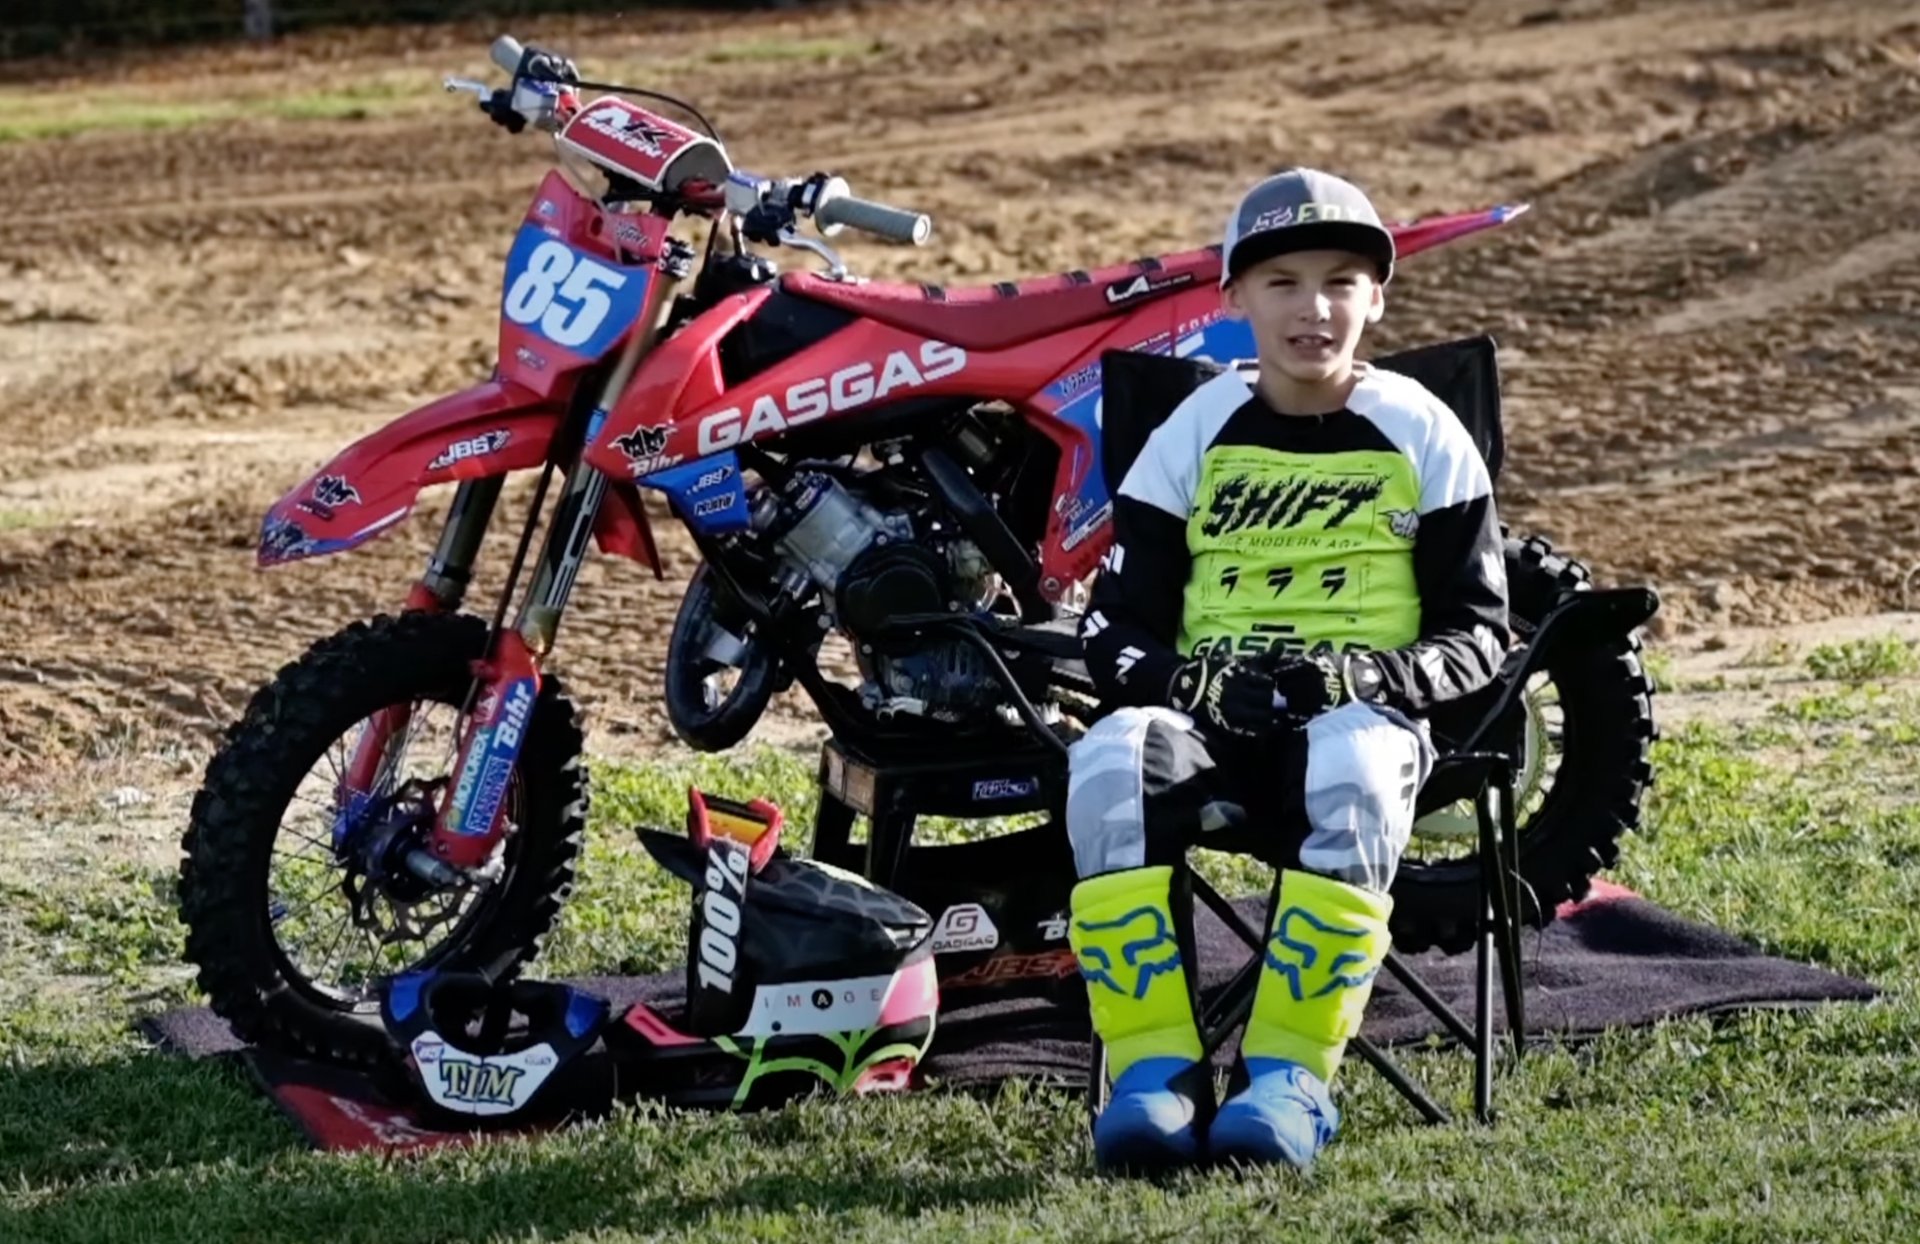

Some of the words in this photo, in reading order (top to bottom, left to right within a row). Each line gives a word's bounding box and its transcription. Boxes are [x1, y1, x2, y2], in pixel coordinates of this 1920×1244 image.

[504, 240, 627, 346] 85
[697, 340, 966, 455] GASGAS
[1201, 473, 1388, 538] SHIFT
[1250, 536, 1321, 547] MODERN
[493, 682, 533, 750] Bihr
[452, 730, 491, 810] MOTOREX
[698, 847, 747, 994] 100%
[932, 935, 995, 950] GASGAS
[439, 1059, 526, 1107] TIM
